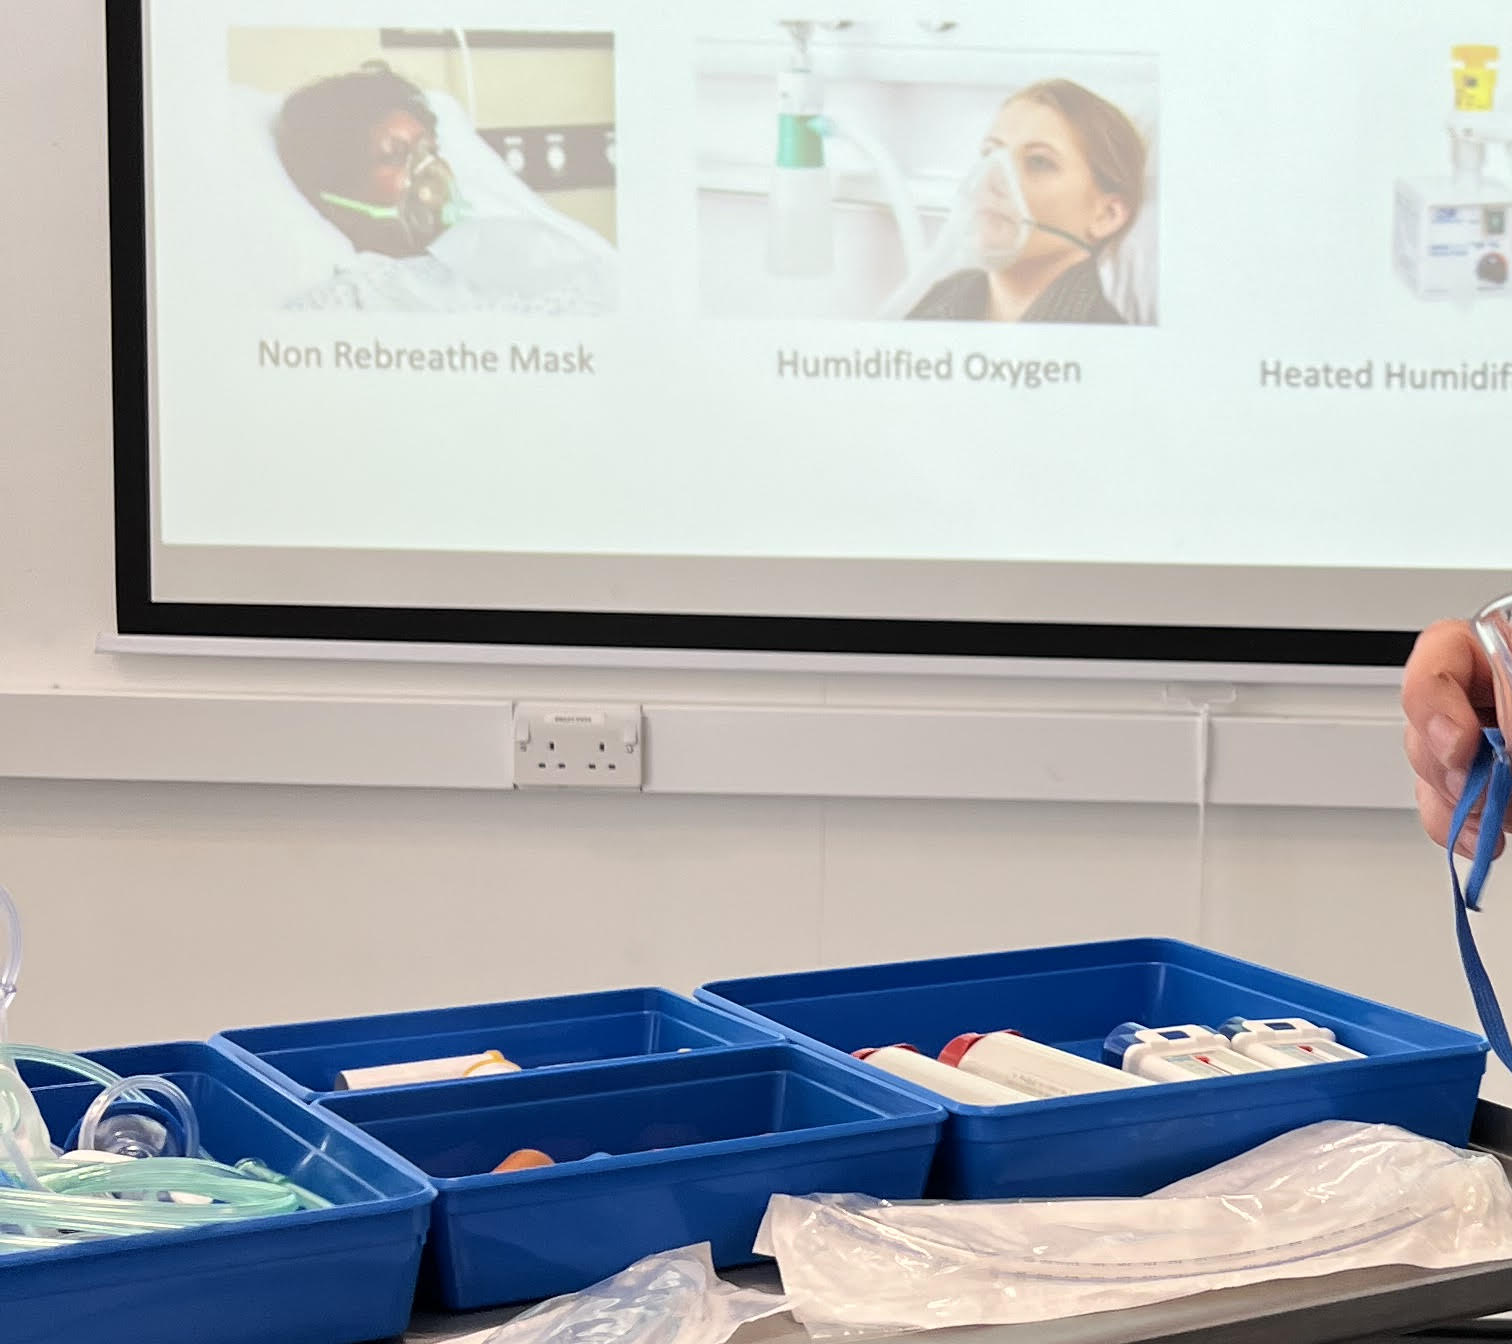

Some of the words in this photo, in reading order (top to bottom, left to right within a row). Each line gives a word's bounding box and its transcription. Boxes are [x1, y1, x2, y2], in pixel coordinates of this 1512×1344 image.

[257, 338, 324, 370] Non
[332, 338, 501, 374] Rebreathe
[508, 342, 596, 376] Mask
[775, 347, 955, 383] Humidified
[961, 351, 1084, 391] Oxygen
[1258, 358, 1376, 391] Heated
